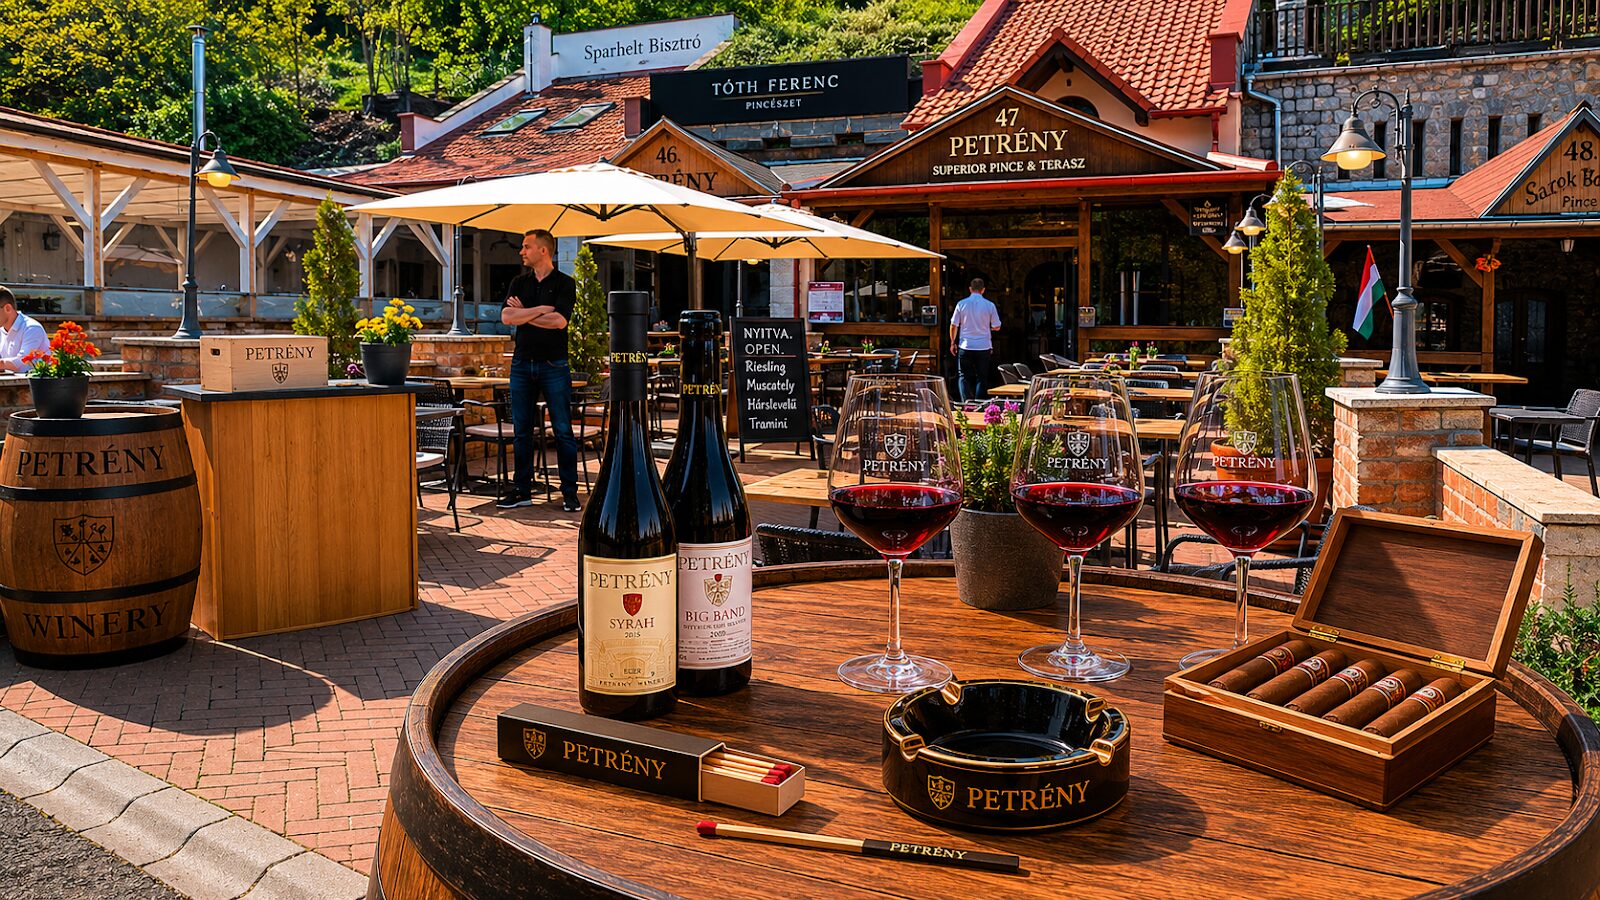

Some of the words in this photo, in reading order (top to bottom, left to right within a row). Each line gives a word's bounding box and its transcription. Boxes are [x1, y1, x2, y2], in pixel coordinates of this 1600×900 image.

[584, 40, 643, 63] Sparhelt
[648, 34, 701, 54] Bisztró
[712, 79, 757, 95] TÓTH
[768, 75, 839, 92] FERENC
[745, 98, 801, 110] PINCÉSZET
[995, 107, 1019, 127] 47
[949, 127, 1068, 157] PETRÉNY
[1563, 140, 1598, 161] 48.
[656, 145, 681, 164] 46.
[932, 162, 987, 176] SUPERIOR
[990, 161, 1024, 173] PINCE
[1027, 160, 1036, 171] &
[1039, 158, 1086, 170] TERASZ
[653, 168, 718, 192] RÉNY
[1525, 170, 1577, 206] Sarok
[1563, 195, 1598, 207] Pince
[743, 327, 793, 340] NYITVA.
[245, 344, 315, 361] PETRÉNY
[744, 343, 785, 355] OPEN.
[745, 360, 786, 376] Riesling
[746, 378, 795, 395] Muscately
[748, 417, 788, 430] Tramini
[16, 443, 166, 478] PETRÉNY
[863, 458, 927, 473] PETRÉNY
[1046, 456, 1109, 470] PETRÉNY
[1211, 454, 1277, 469] PETRÉNY
[679, 550, 749, 571] PETRÉNY
[589, 570, 673, 590] PETRÉNY
[23, 602, 171, 641] WINERY
[609, 617, 655, 630] SYRAH
[685, 610, 710, 623] BIG
[713, 606, 746, 622] BAND
[562, 740, 667, 780] PETRÉNY
[966, 779, 1091, 812] PETRÉNY
[889, 842, 968, 860] PETRÉNY
